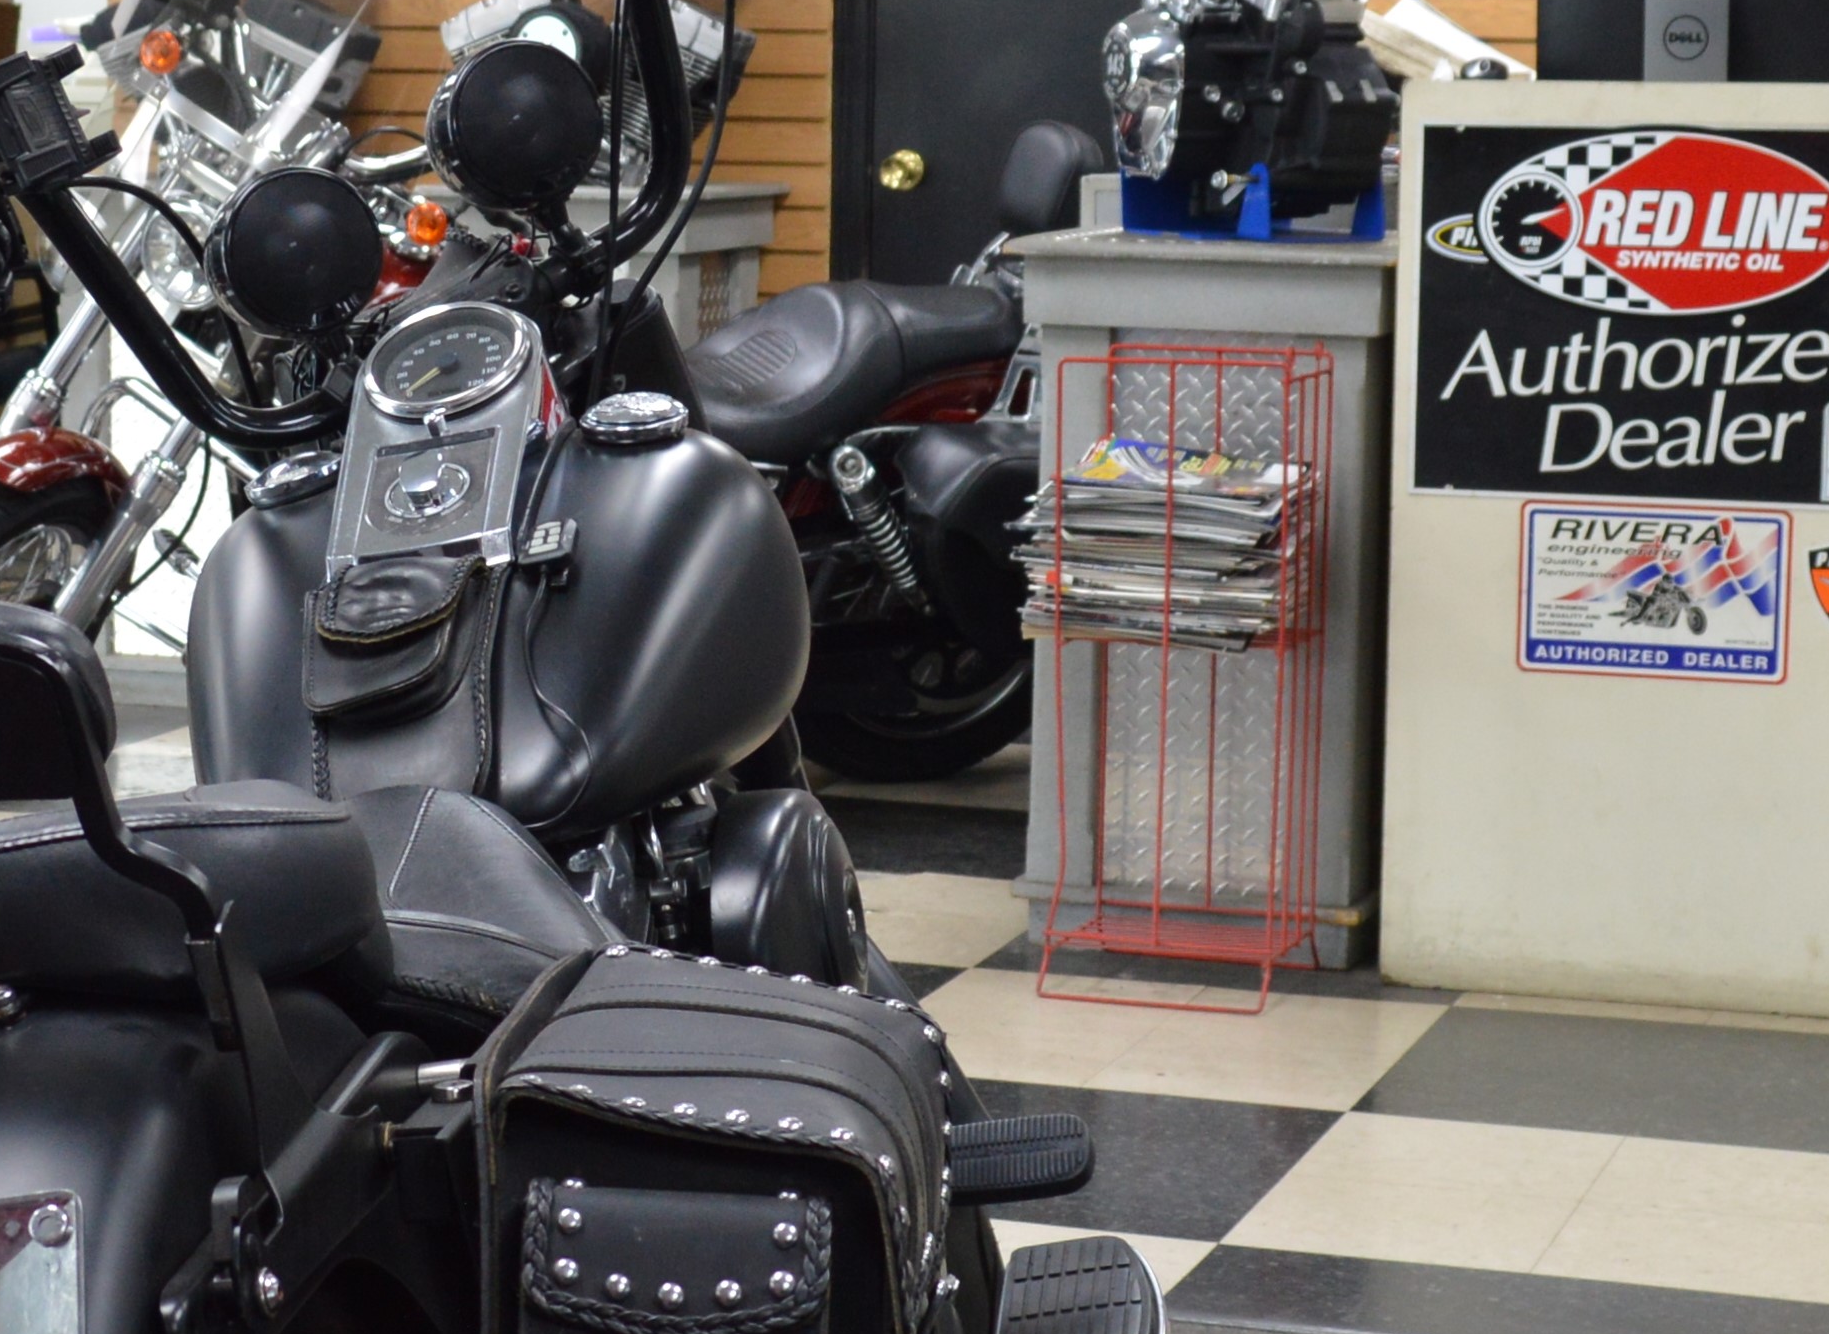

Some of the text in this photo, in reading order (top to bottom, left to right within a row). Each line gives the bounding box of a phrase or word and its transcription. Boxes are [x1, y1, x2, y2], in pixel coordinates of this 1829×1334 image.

[1668, 32, 1703, 44] DELL
[1584, 189, 1828, 251] RED LINE
[1616, 250, 1784, 271] SYNTHETIC OIL
[1539, 391, 1806, 473] Dealer
[1551, 517, 1724, 545] RIVERA
[1547, 542, 1683, 560] engineering
[1535, 645, 1769, 670] AUTHORIZED DEALER
